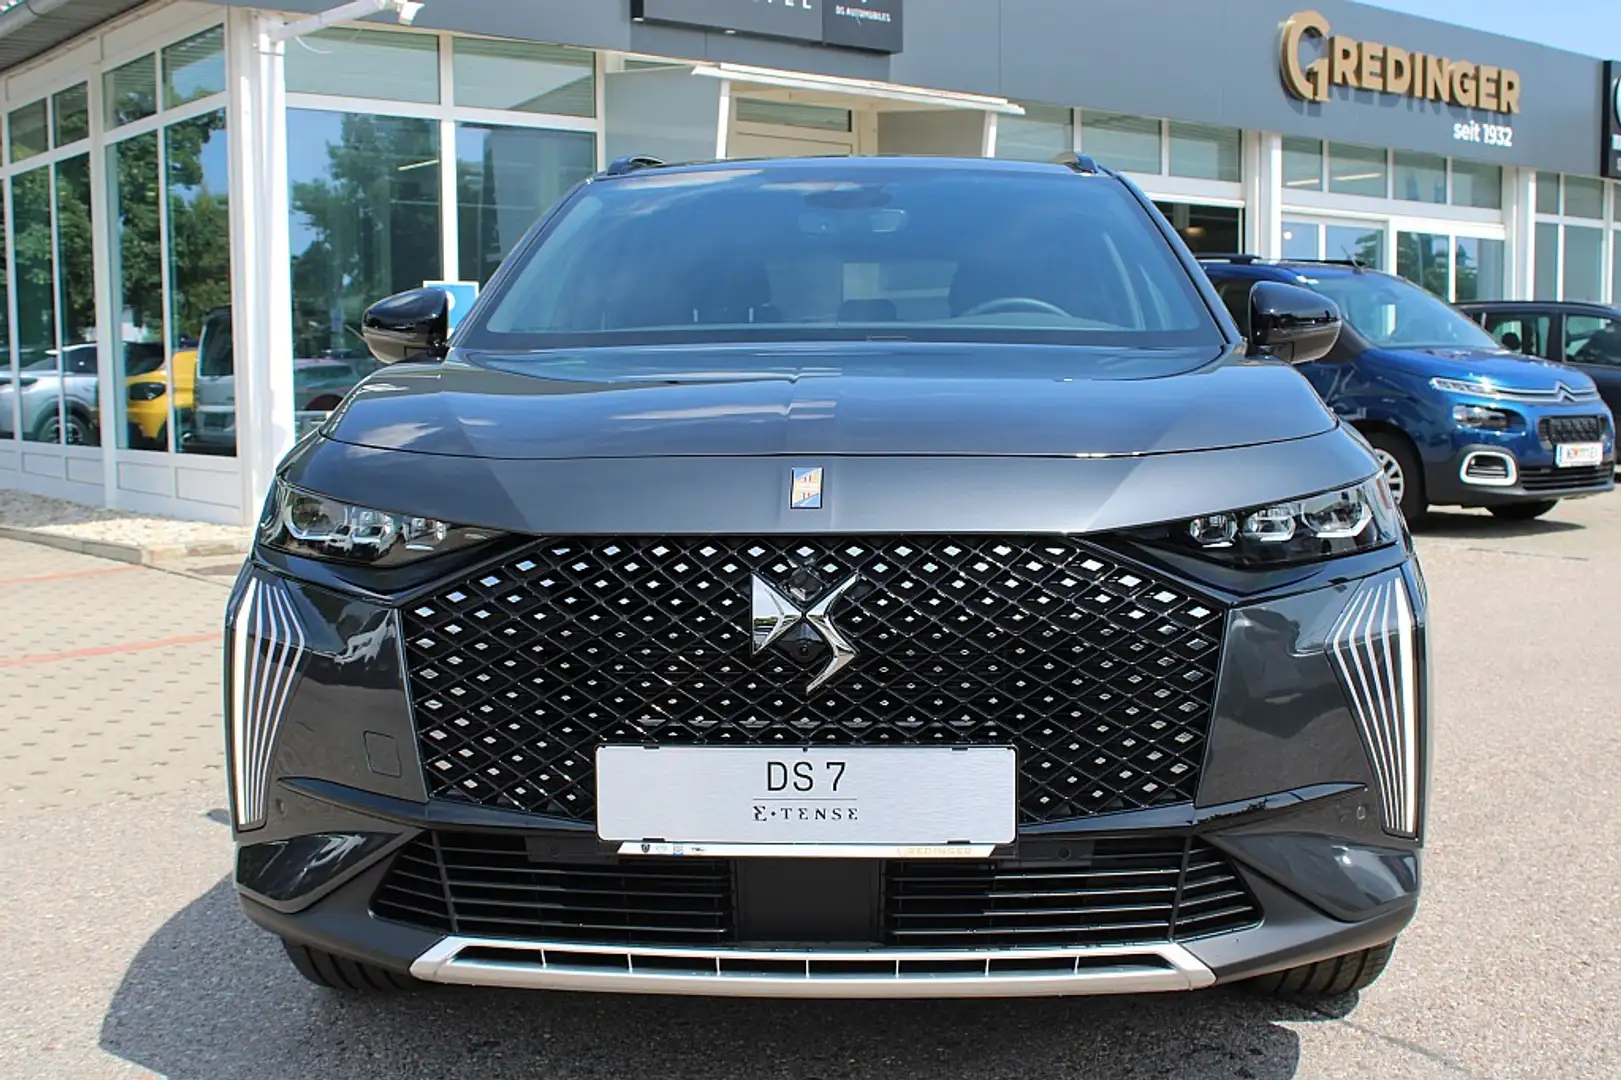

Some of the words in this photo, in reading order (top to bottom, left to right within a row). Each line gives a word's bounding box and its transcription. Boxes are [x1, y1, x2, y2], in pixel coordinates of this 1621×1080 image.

[1279, 10, 1520, 114] GREDINGER
[1453, 119, 1480, 142] seit
[1482, 123, 1513, 147] 1932
[767, 761, 813, 791] DS
[826, 761, 846, 791] 7
